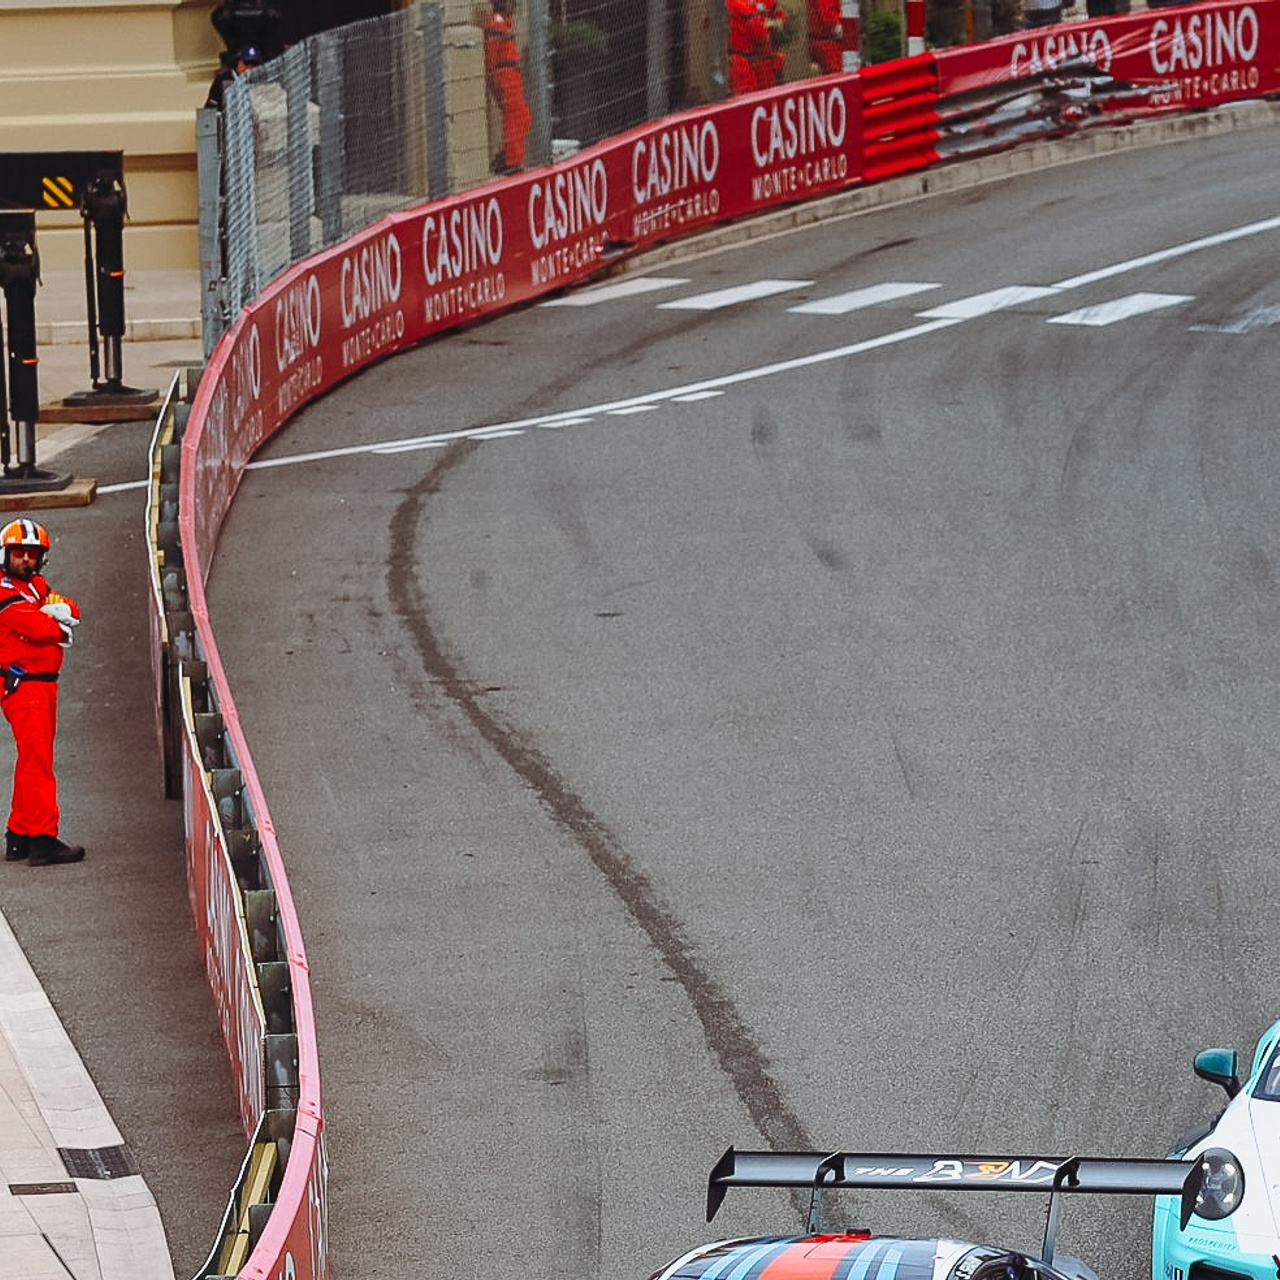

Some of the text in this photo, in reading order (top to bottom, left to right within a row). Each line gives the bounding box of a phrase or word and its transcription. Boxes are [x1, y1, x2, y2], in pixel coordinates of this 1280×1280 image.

[1150, 6, 1259, 74] CASINO
[1210, 66, 1260, 95] CARLO
[752, 87, 846, 167] CASINO
[633, 120, 719, 203] CASINO
[752, 153, 847, 199] MONTE CARLO
[528, 158, 607, 250] CASINO
[677, 189, 720, 226] CARLO
[421, 198, 503, 286] CASINO
[531, 247, 569, 287] MONTE
[340, 232, 402, 328] CASINO
[425, 273, 506, 323] MONTE CARLO
[375, 310, 405, 349] CARLO
